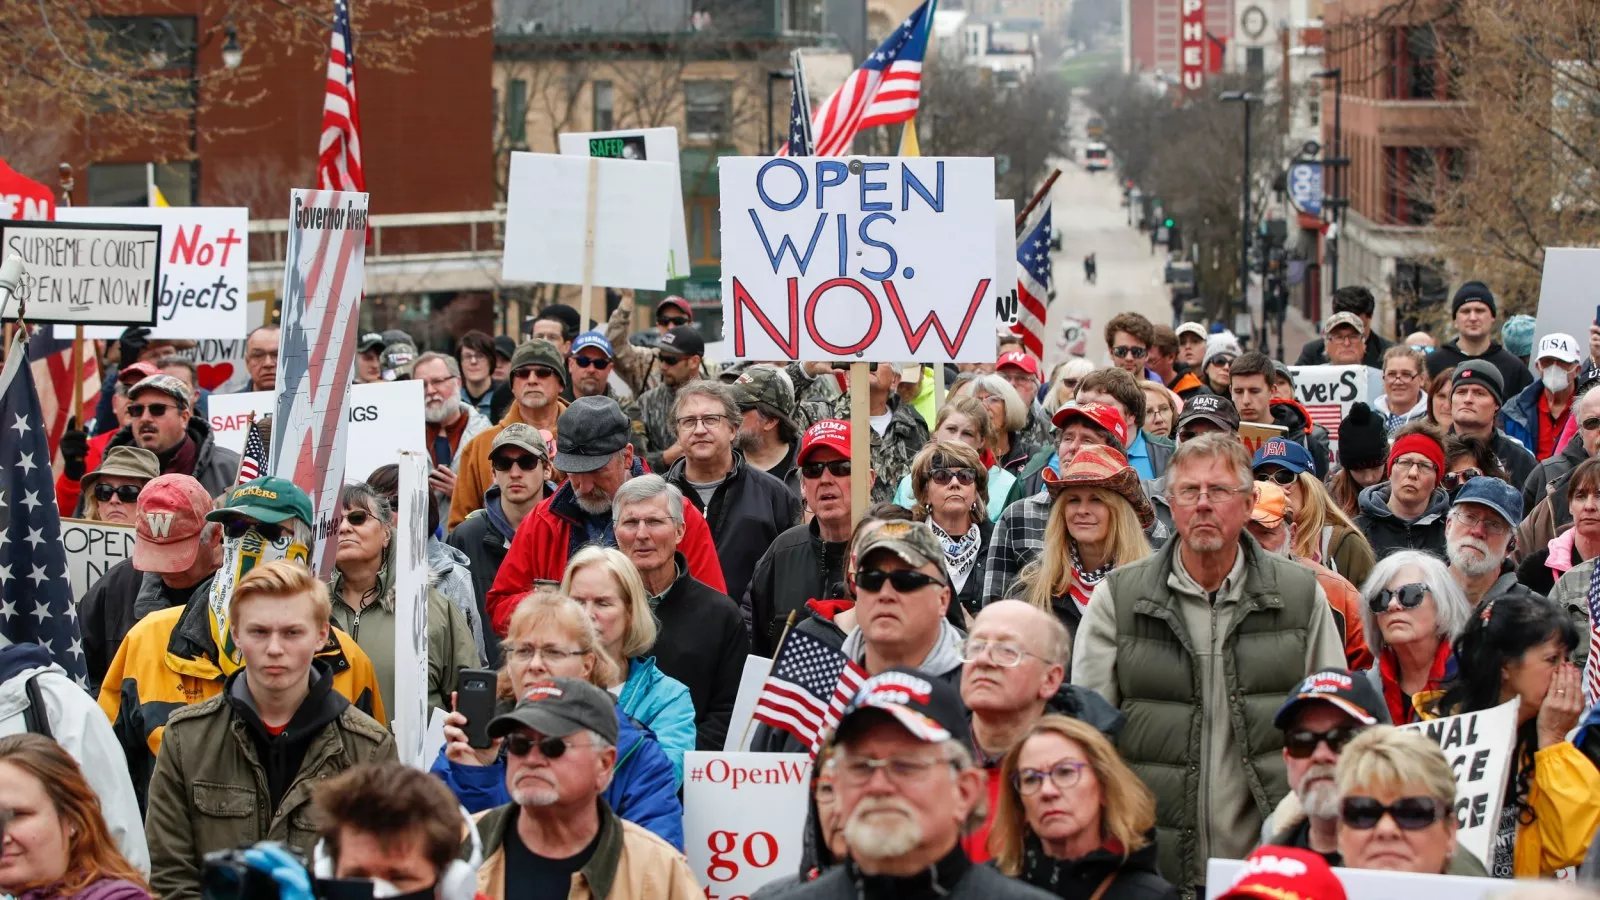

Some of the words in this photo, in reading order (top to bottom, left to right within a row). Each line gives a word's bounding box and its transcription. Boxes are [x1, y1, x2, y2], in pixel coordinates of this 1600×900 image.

[756, 158, 944, 213] OPEN
[0, 194, 48, 220] EN
[295, 197, 345, 230] Governor
[346, 200, 367, 230] Evers
[9, 235, 86, 268] SUPREME
[90, 238, 155, 269] COURT
[169, 224, 241, 267] Not
[748, 208, 914, 281] WIS.
[68, 277, 95, 305] WI
[98, 278, 151, 307] NOW!
[157, 274, 239, 321] bjects
[996, 289, 1018, 323] N!
[733, 276, 991, 360] NOW
[1542, 338, 1568, 352] USA
[349, 405, 378, 422] GS
[809, 421, 847, 436] TRUMP
[1262, 442, 1287, 458] USA
[147, 513, 174, 538] W
[1407, 713, 1478, 750] NAL
[690, 759, 813, 790] #OpenW
[1451, 749, 1490, 782] CE
[1456, 793, 1489, 830] CE
[707, 830, 778, 882] go
